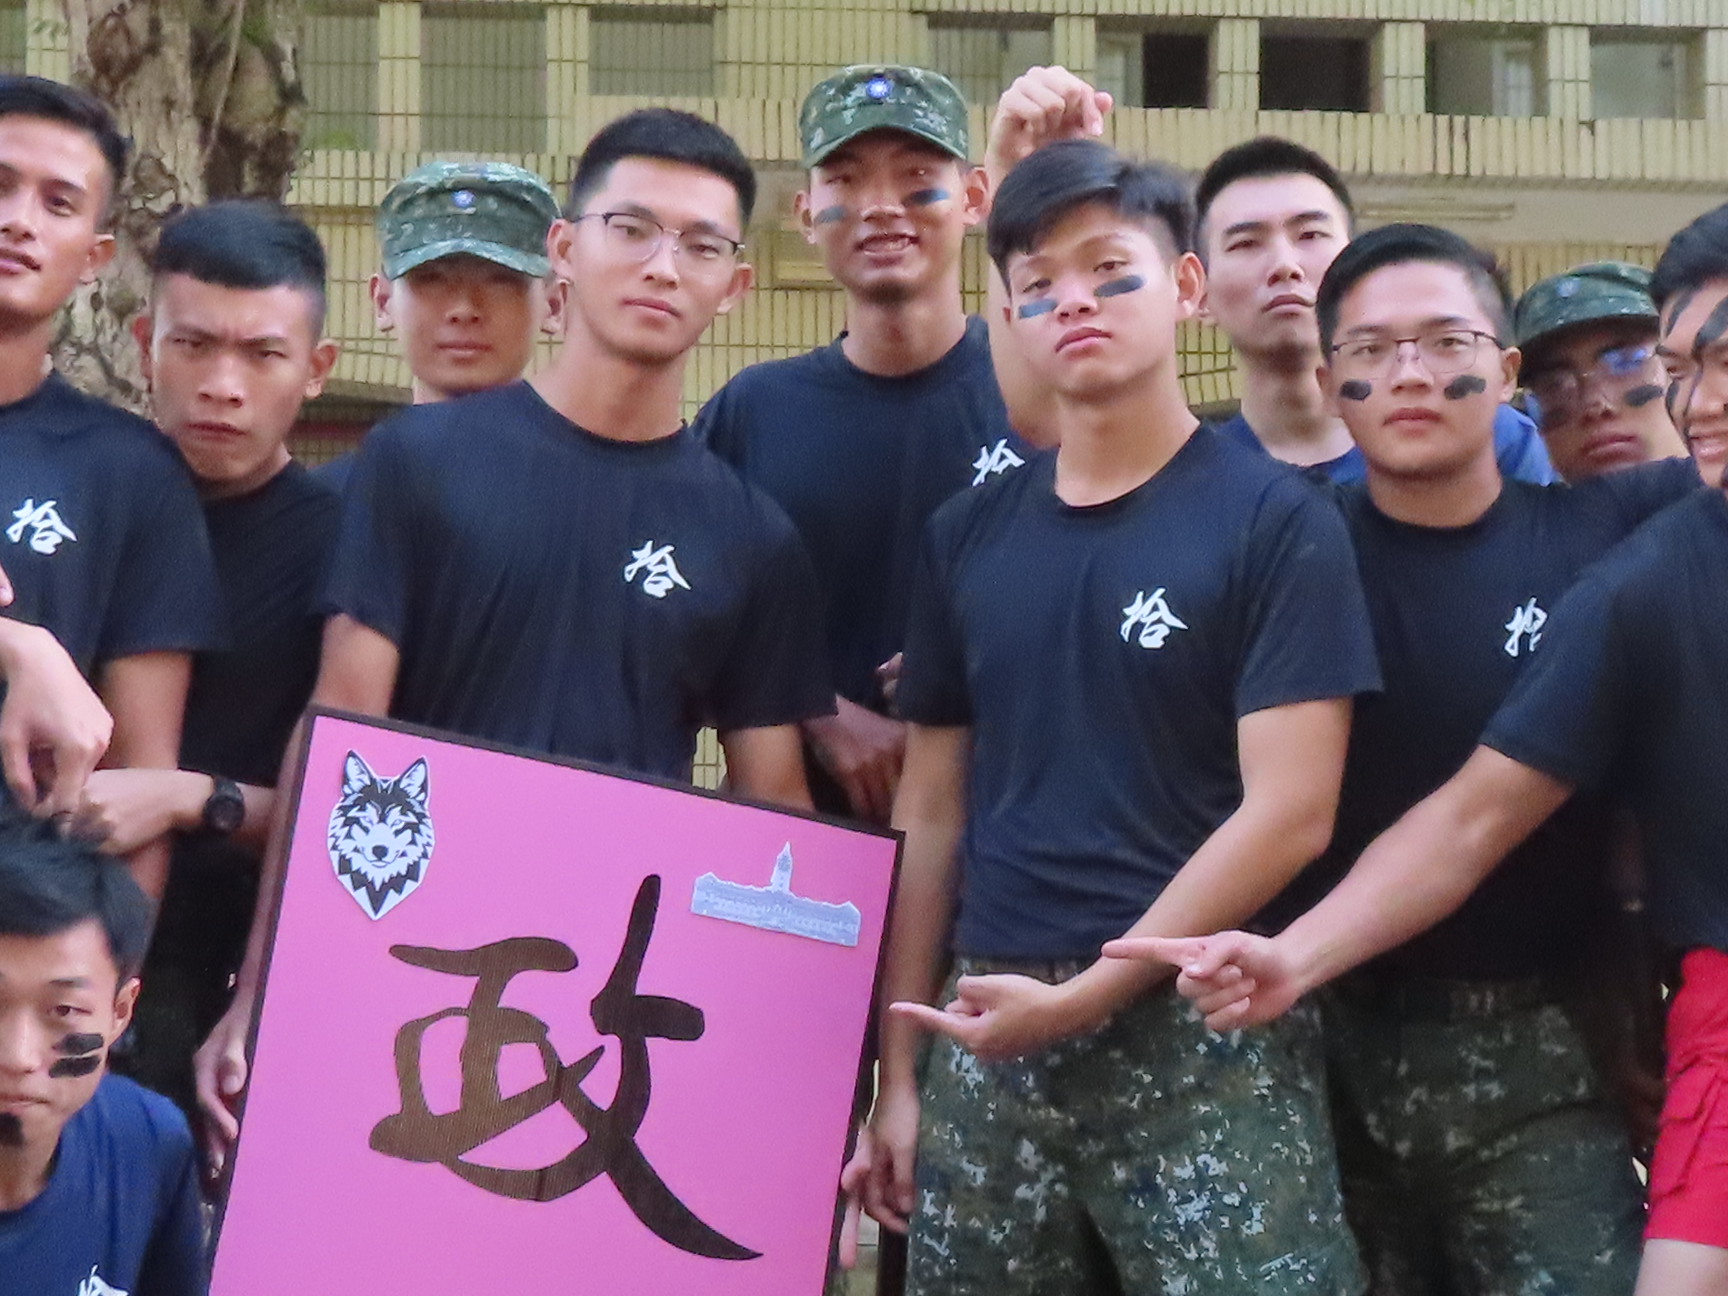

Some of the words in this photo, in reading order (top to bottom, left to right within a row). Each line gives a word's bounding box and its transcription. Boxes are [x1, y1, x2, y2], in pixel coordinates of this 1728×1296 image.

[5, 498, 77, 556] 拾
[623, 540, 692, 598] 拾
[1120, 587, 1188, 649] 拾
[368, 873, 764, 1261] 政
